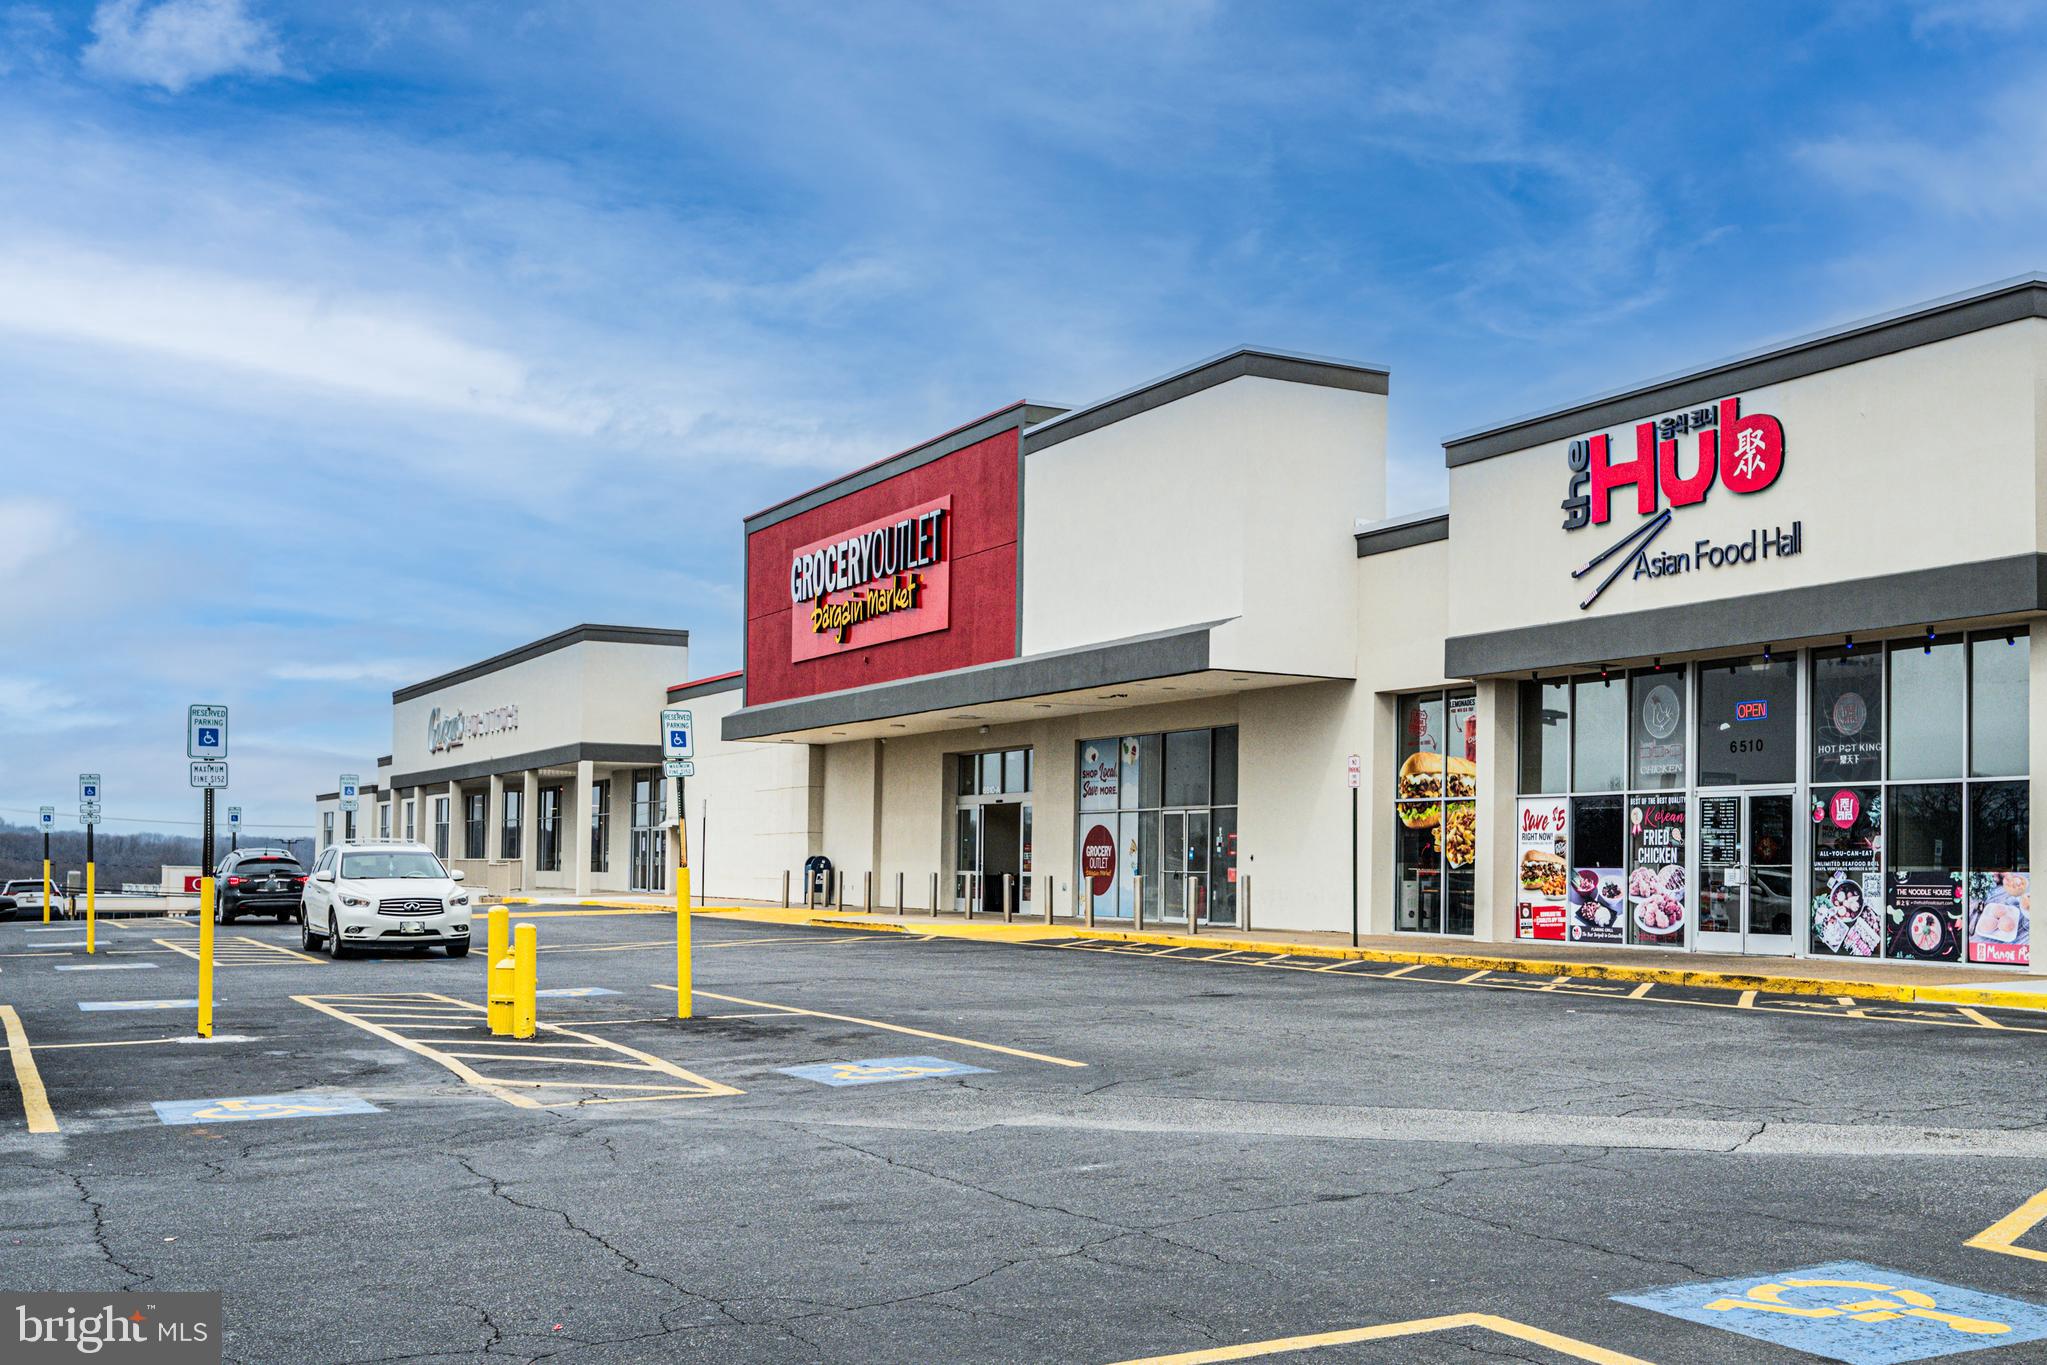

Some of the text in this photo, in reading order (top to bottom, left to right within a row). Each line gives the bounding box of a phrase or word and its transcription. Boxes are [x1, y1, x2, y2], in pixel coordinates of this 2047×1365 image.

[1733, 427, 1766, 480] 聚
[1589, 397, 1785, 524] Hub
[1561, 439, 1590, 531] the
[1633, 521, 1802, 580] Asian Food Hall
[811, 571, 916, 644] bargain market
[192, 708, 226, 718] RESERVED
[665, 713, 690, 721] RESERVED
[1738, 703, 1766, 718] OPEN
[194, 719, 224, 727] PARKING
[1730, 739, 1763, 753] 6510
[1818, 743, 1882, 754] HOT POT KING
[1082, 769, 1097, 779] SHOP
[1640, 763, 1682, 775] CHICKEN
[210, 775, 225, 783] $152
[1083, 780, 1117, 798] Save MORE.
[1522, 806, 1565, 832] Save $5
[1644, 805, 1685, 828] Korean
[1521, 832, 1538, 841] RIGHT
[1643, 829, 1670, 846] FRIED
[1086, 845, 1113, 857] GROCERY
[1638, 847, 1678, 864] CHICKEN
[1089, 857, 1109, 869] OUTLET
[1842, 860, 1866, 868] SEAFOOD
[1897, 888, 1952, 896] THE NOODLE HOUSE
